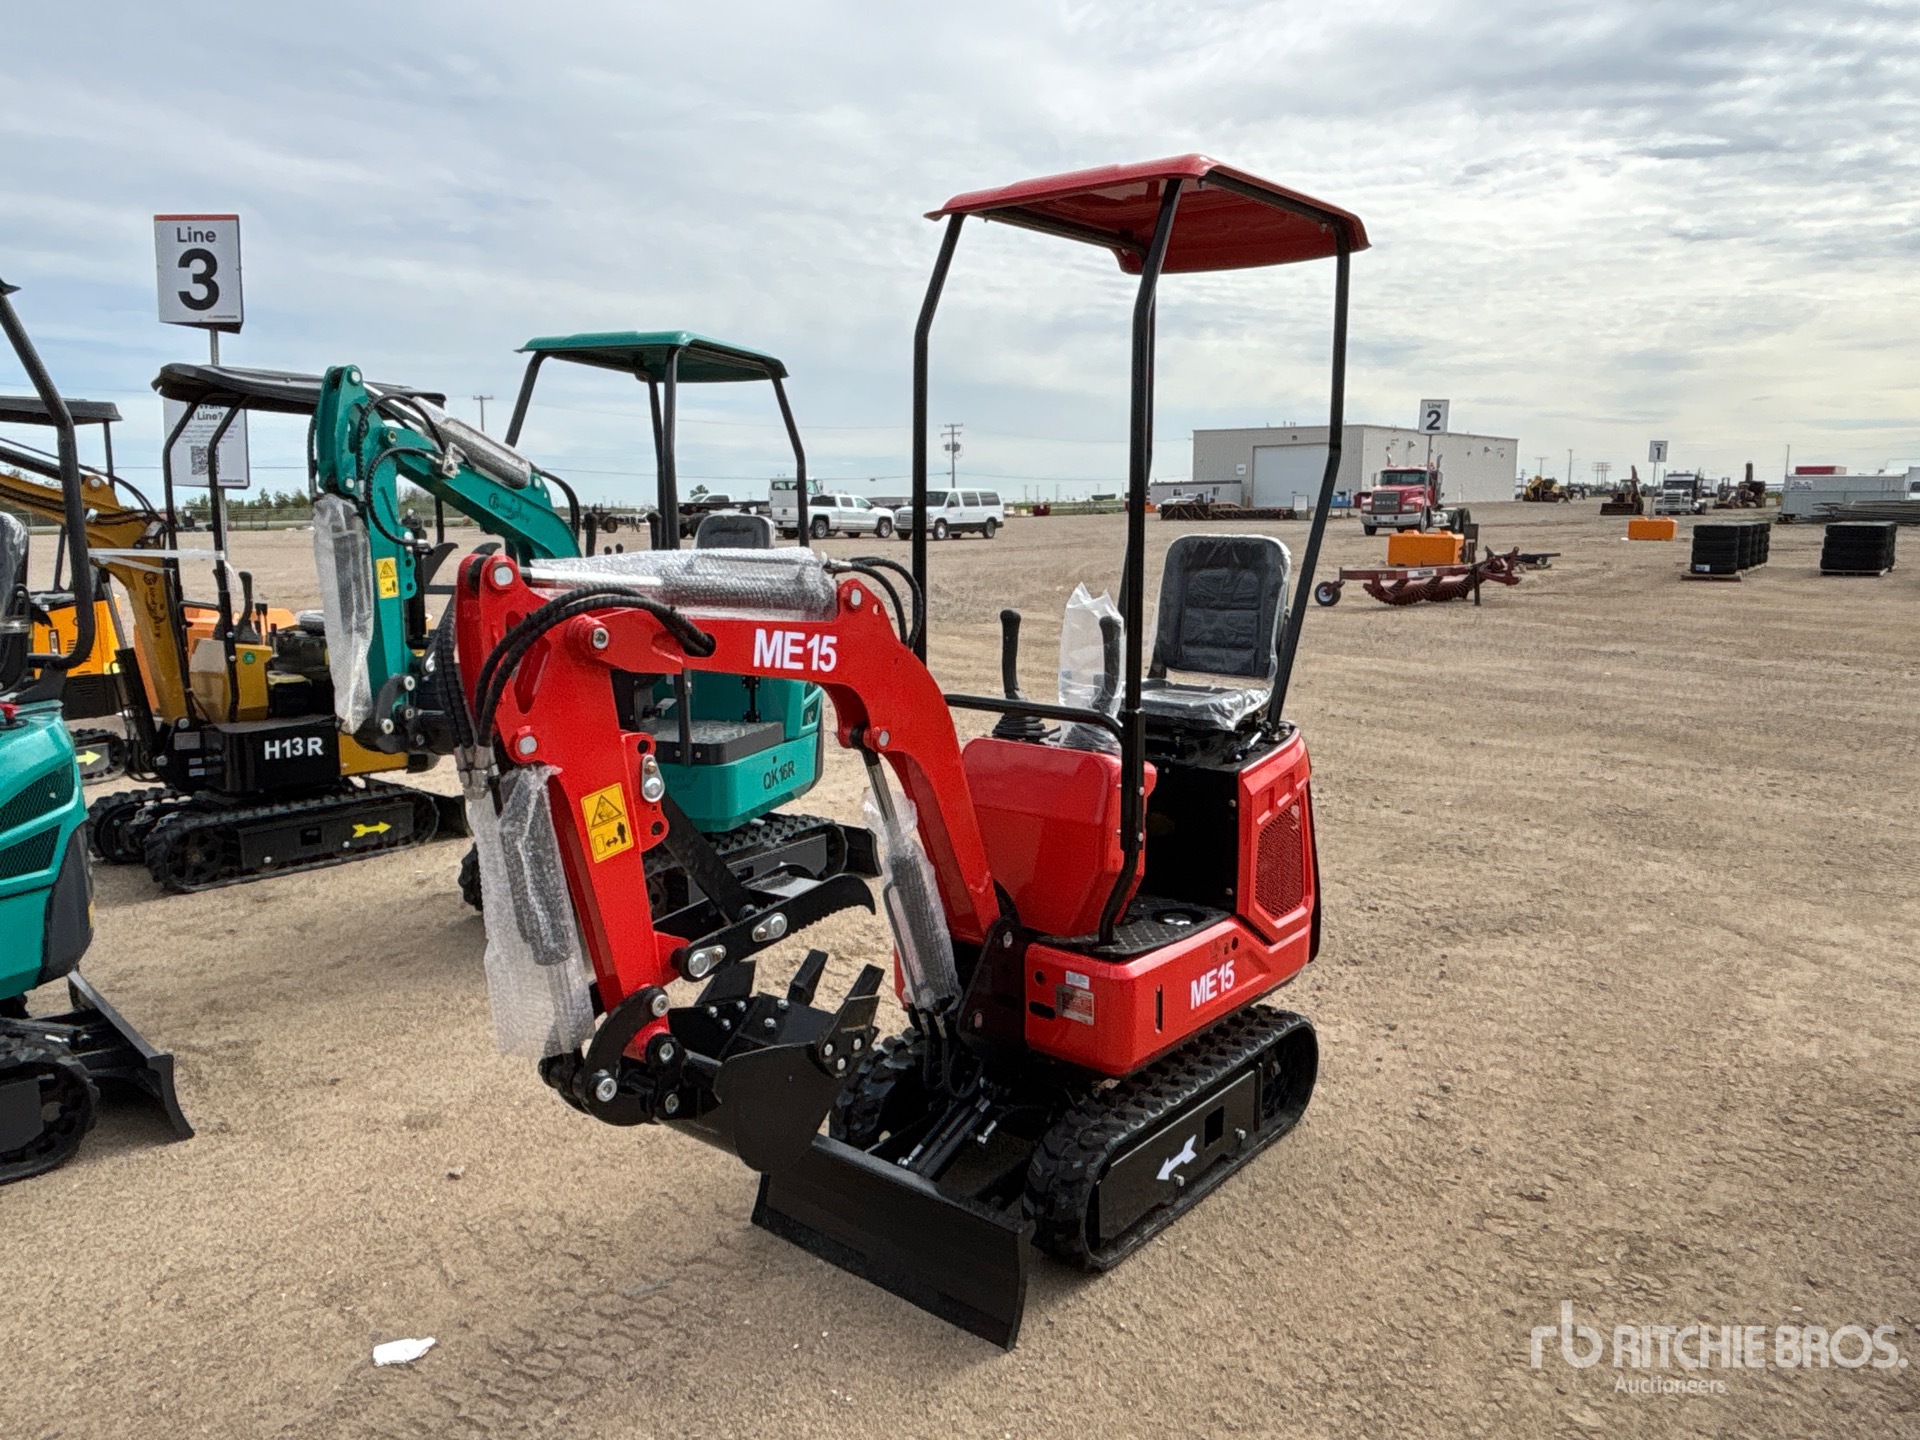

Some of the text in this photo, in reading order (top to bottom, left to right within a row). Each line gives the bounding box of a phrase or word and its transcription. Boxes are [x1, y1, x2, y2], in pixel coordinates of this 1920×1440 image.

[176, 226, 217, 243] Line
[178, 247, 220, 311] 3
[197, 411, 224, 421] Line?
[1426, 409, 1441, 431] 2
[1655, 446, 1661, 460] 1
[753, 628, 838, 673] ME15
[1190, 959, 1235, 1010] ME15
